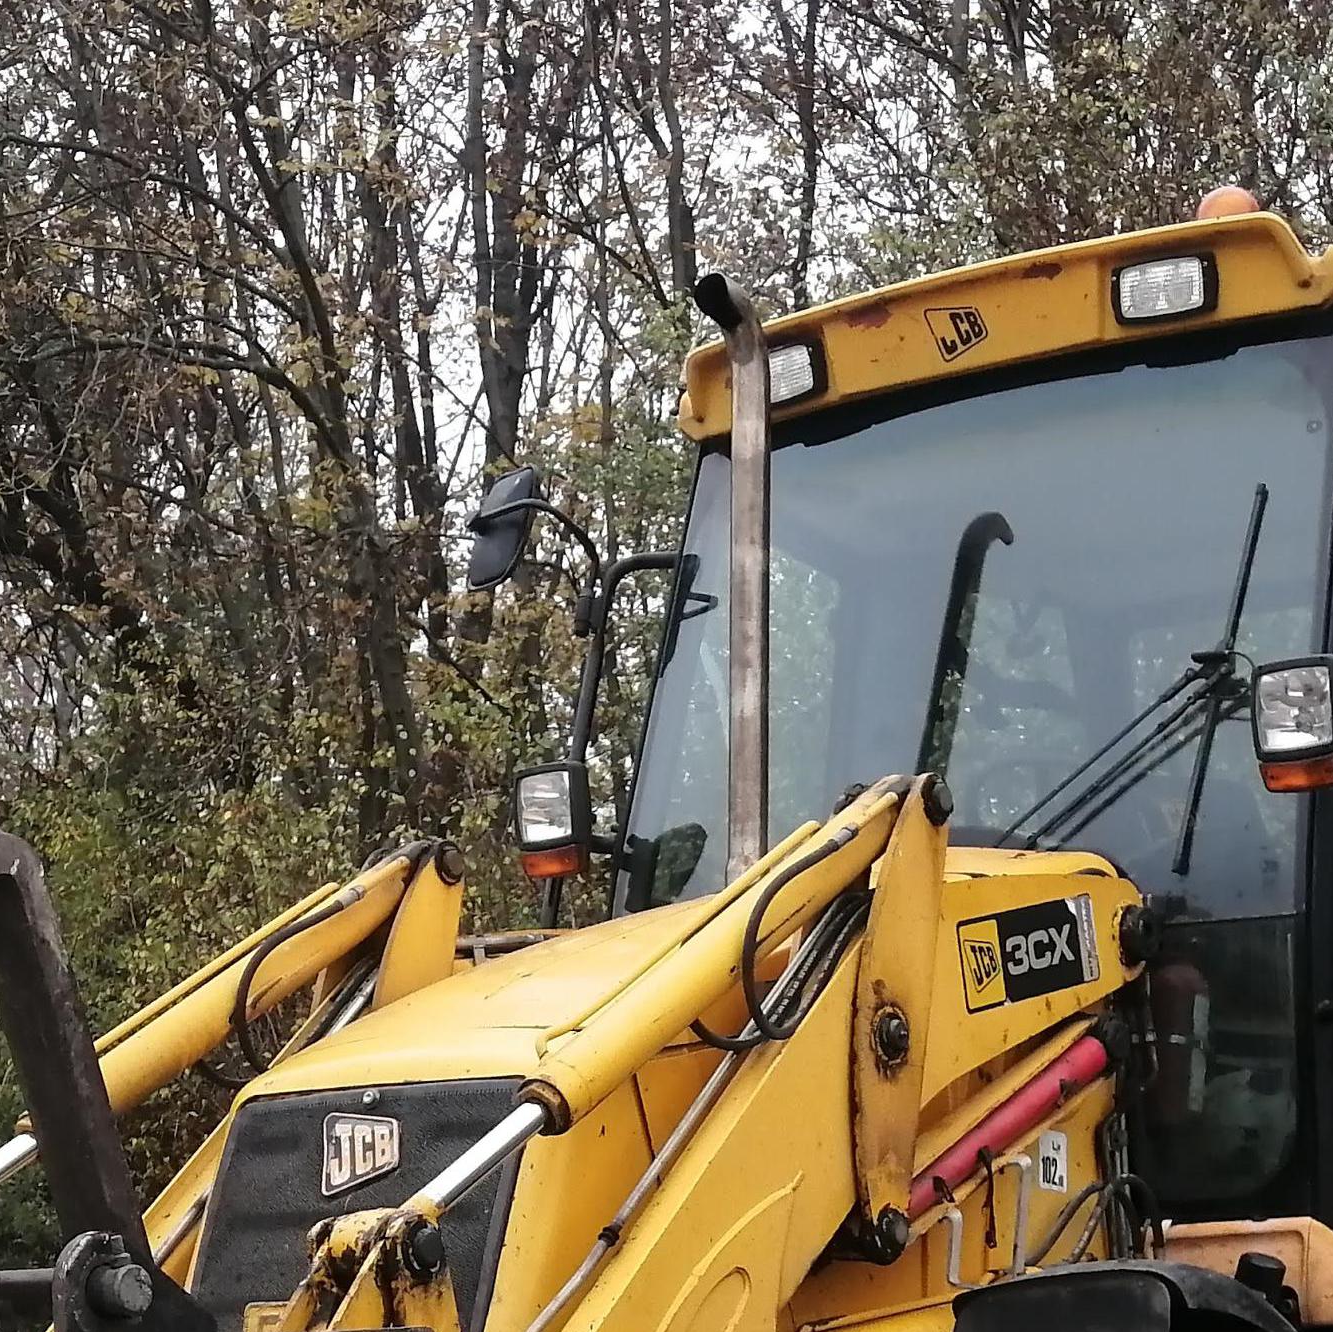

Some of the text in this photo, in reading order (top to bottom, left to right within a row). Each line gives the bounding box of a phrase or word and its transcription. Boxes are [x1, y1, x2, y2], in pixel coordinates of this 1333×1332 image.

[970, 944, 998, 986] JCB
[1005, 923, 1075, 976] 3CX
[330, 1122, 393, 1186] JCB
[1041, 1155, 1058, 1186] 102
